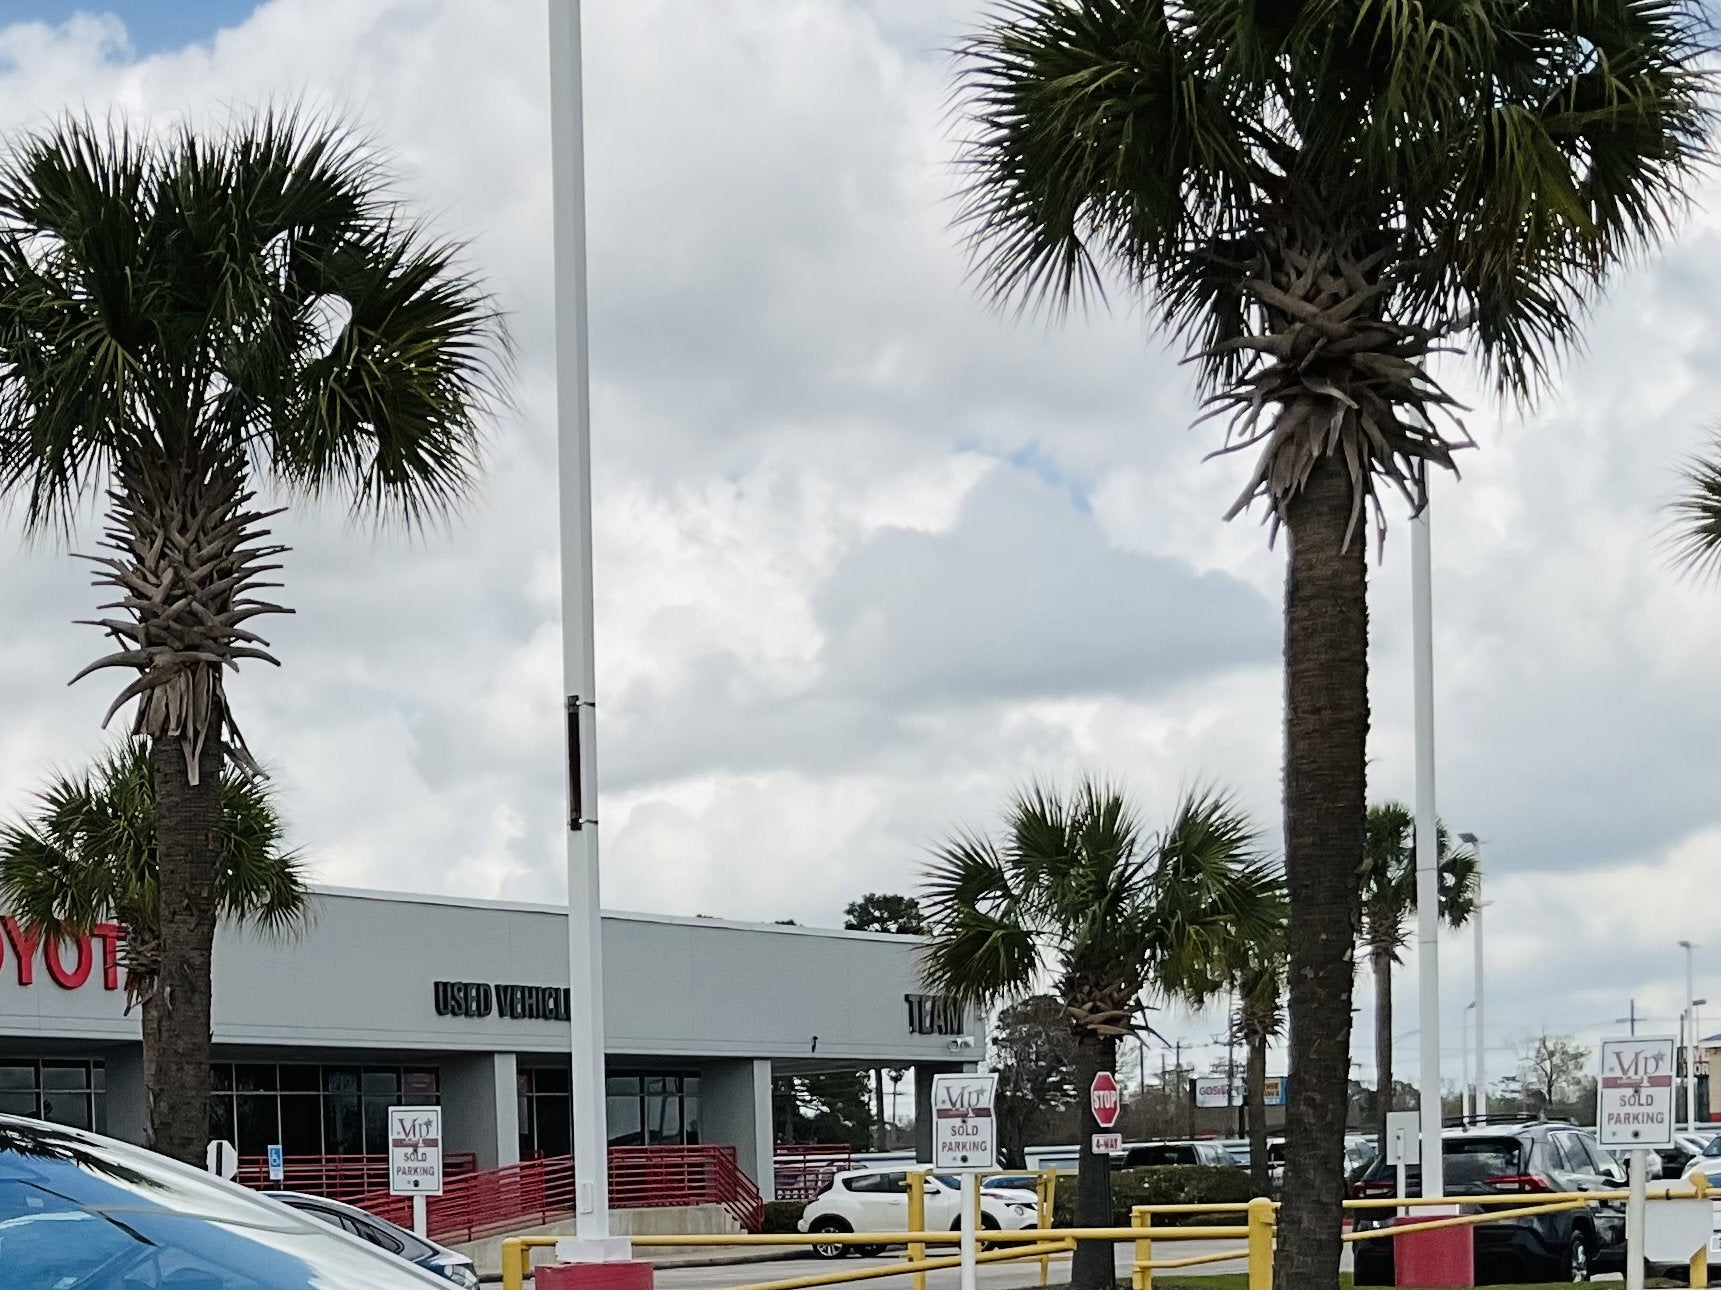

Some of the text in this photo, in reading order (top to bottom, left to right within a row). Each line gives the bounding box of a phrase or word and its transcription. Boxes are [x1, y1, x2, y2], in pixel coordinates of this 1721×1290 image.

[433, 981, 571, 1022] USED VEHICL
[904, 993, 965, 1036] TEAM
[1094, 1090, 1117, 1109] STOP
[1618, 1094, 1654, 1107] SOLD
[1607, 1111, 1665, 1126] PARKING
[950, 1124, 979, 1137] SOLD
[941, 1139, 988, 1153] PARKING
[1095, 1137, 1118, 1150] 4-WAY
[403, 1152, 427, 1163] SOLD
[396, 1165, 435, 1176] PARKING
